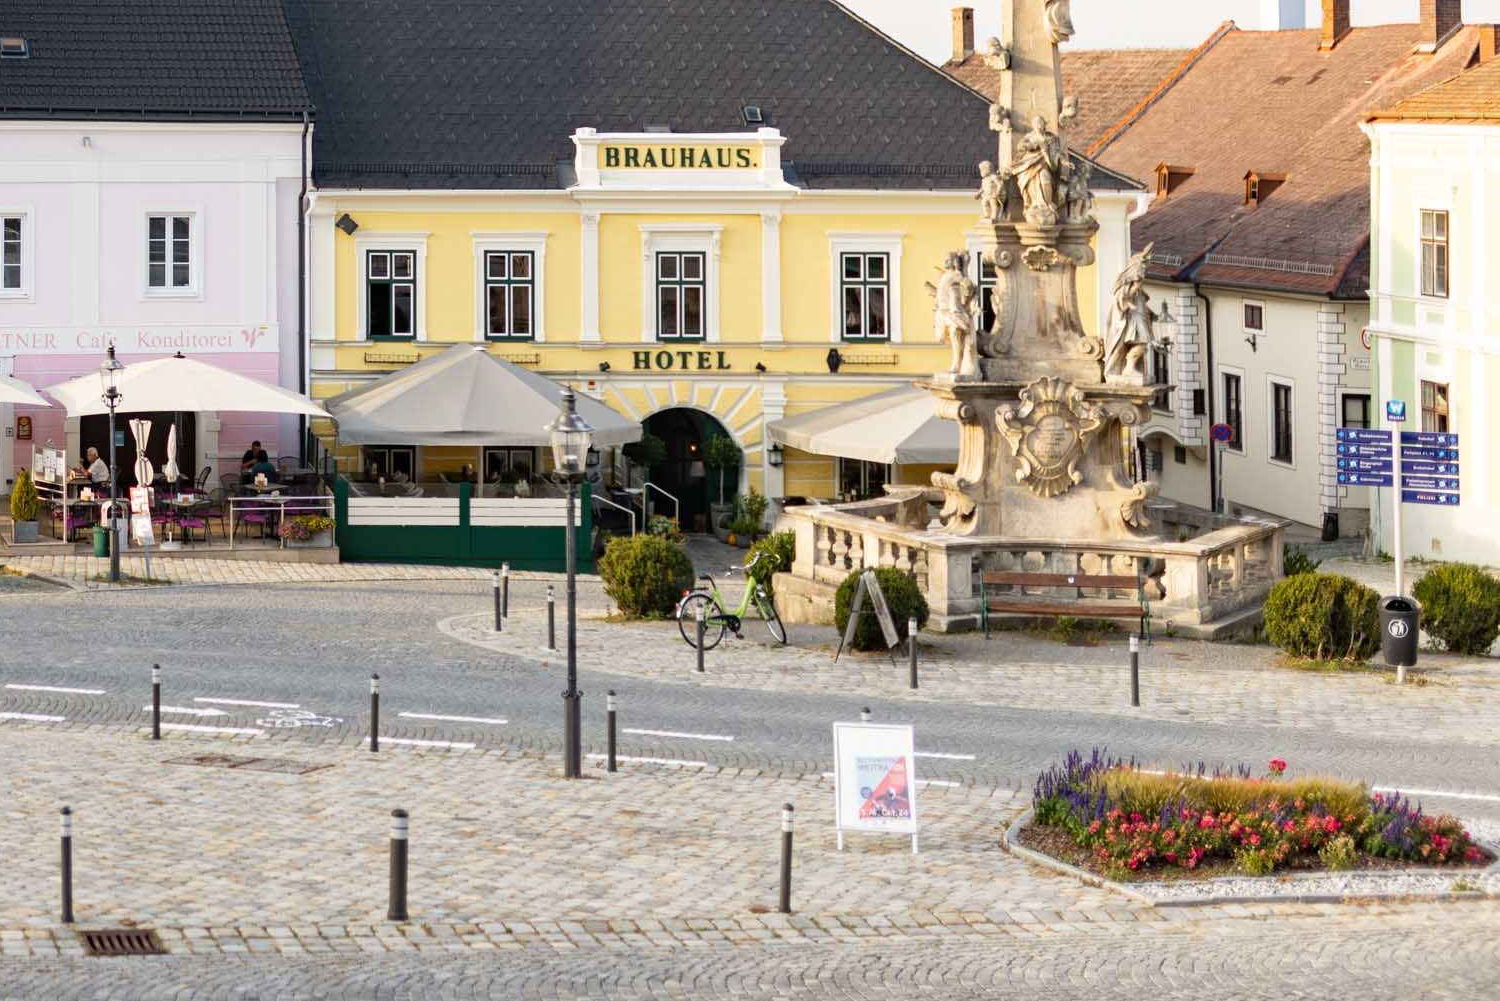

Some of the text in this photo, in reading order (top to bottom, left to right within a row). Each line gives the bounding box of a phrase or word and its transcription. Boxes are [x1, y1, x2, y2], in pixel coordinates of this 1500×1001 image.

[604, 146, 758, 168] BRAUHAUS.
[138, 330, 233, 349] Konditorei
[632, 350, 732, 370] HOTEL
